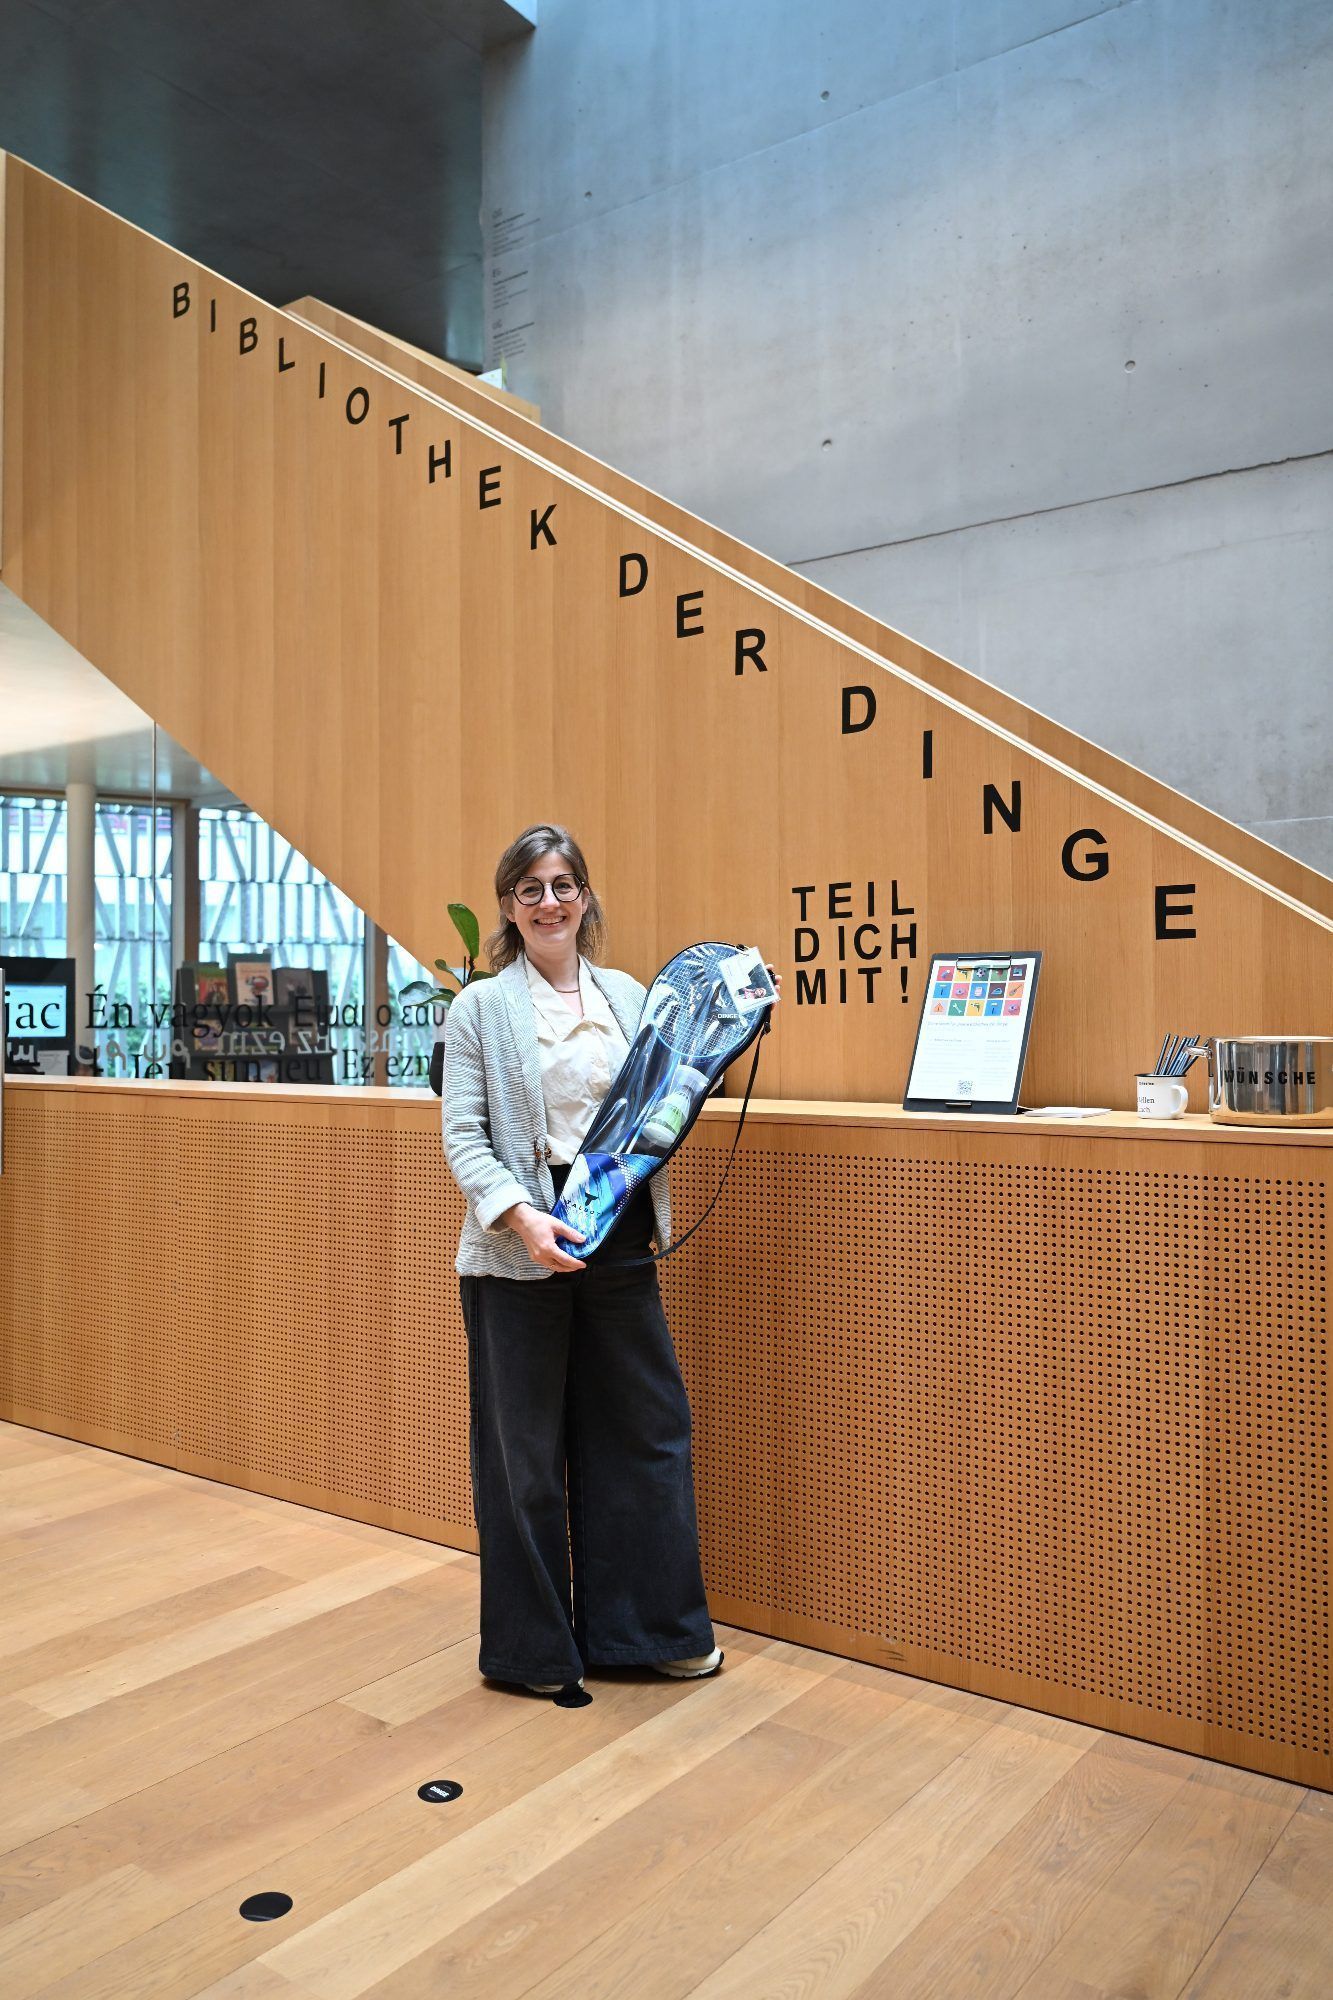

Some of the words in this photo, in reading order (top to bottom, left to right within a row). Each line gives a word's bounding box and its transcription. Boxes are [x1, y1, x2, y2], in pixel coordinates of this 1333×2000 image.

[173, 282, 558, 550] BIBLIOTHEK
[619, 552, 768, 675] DER
[841, 686, 1196, 940] DINGE
[792, 880, 914, 921] TEIL
[795, 923, 916, 962] DICH
[796, 966, 908, 1005] MIT!
[85, 984, 136, 1029] Én
[148, 994, 273, 1038] vagyok
[342, 1049, 375, 1079] Ez
[1224, 1066, 1316, 1085] WÜNSCHE
